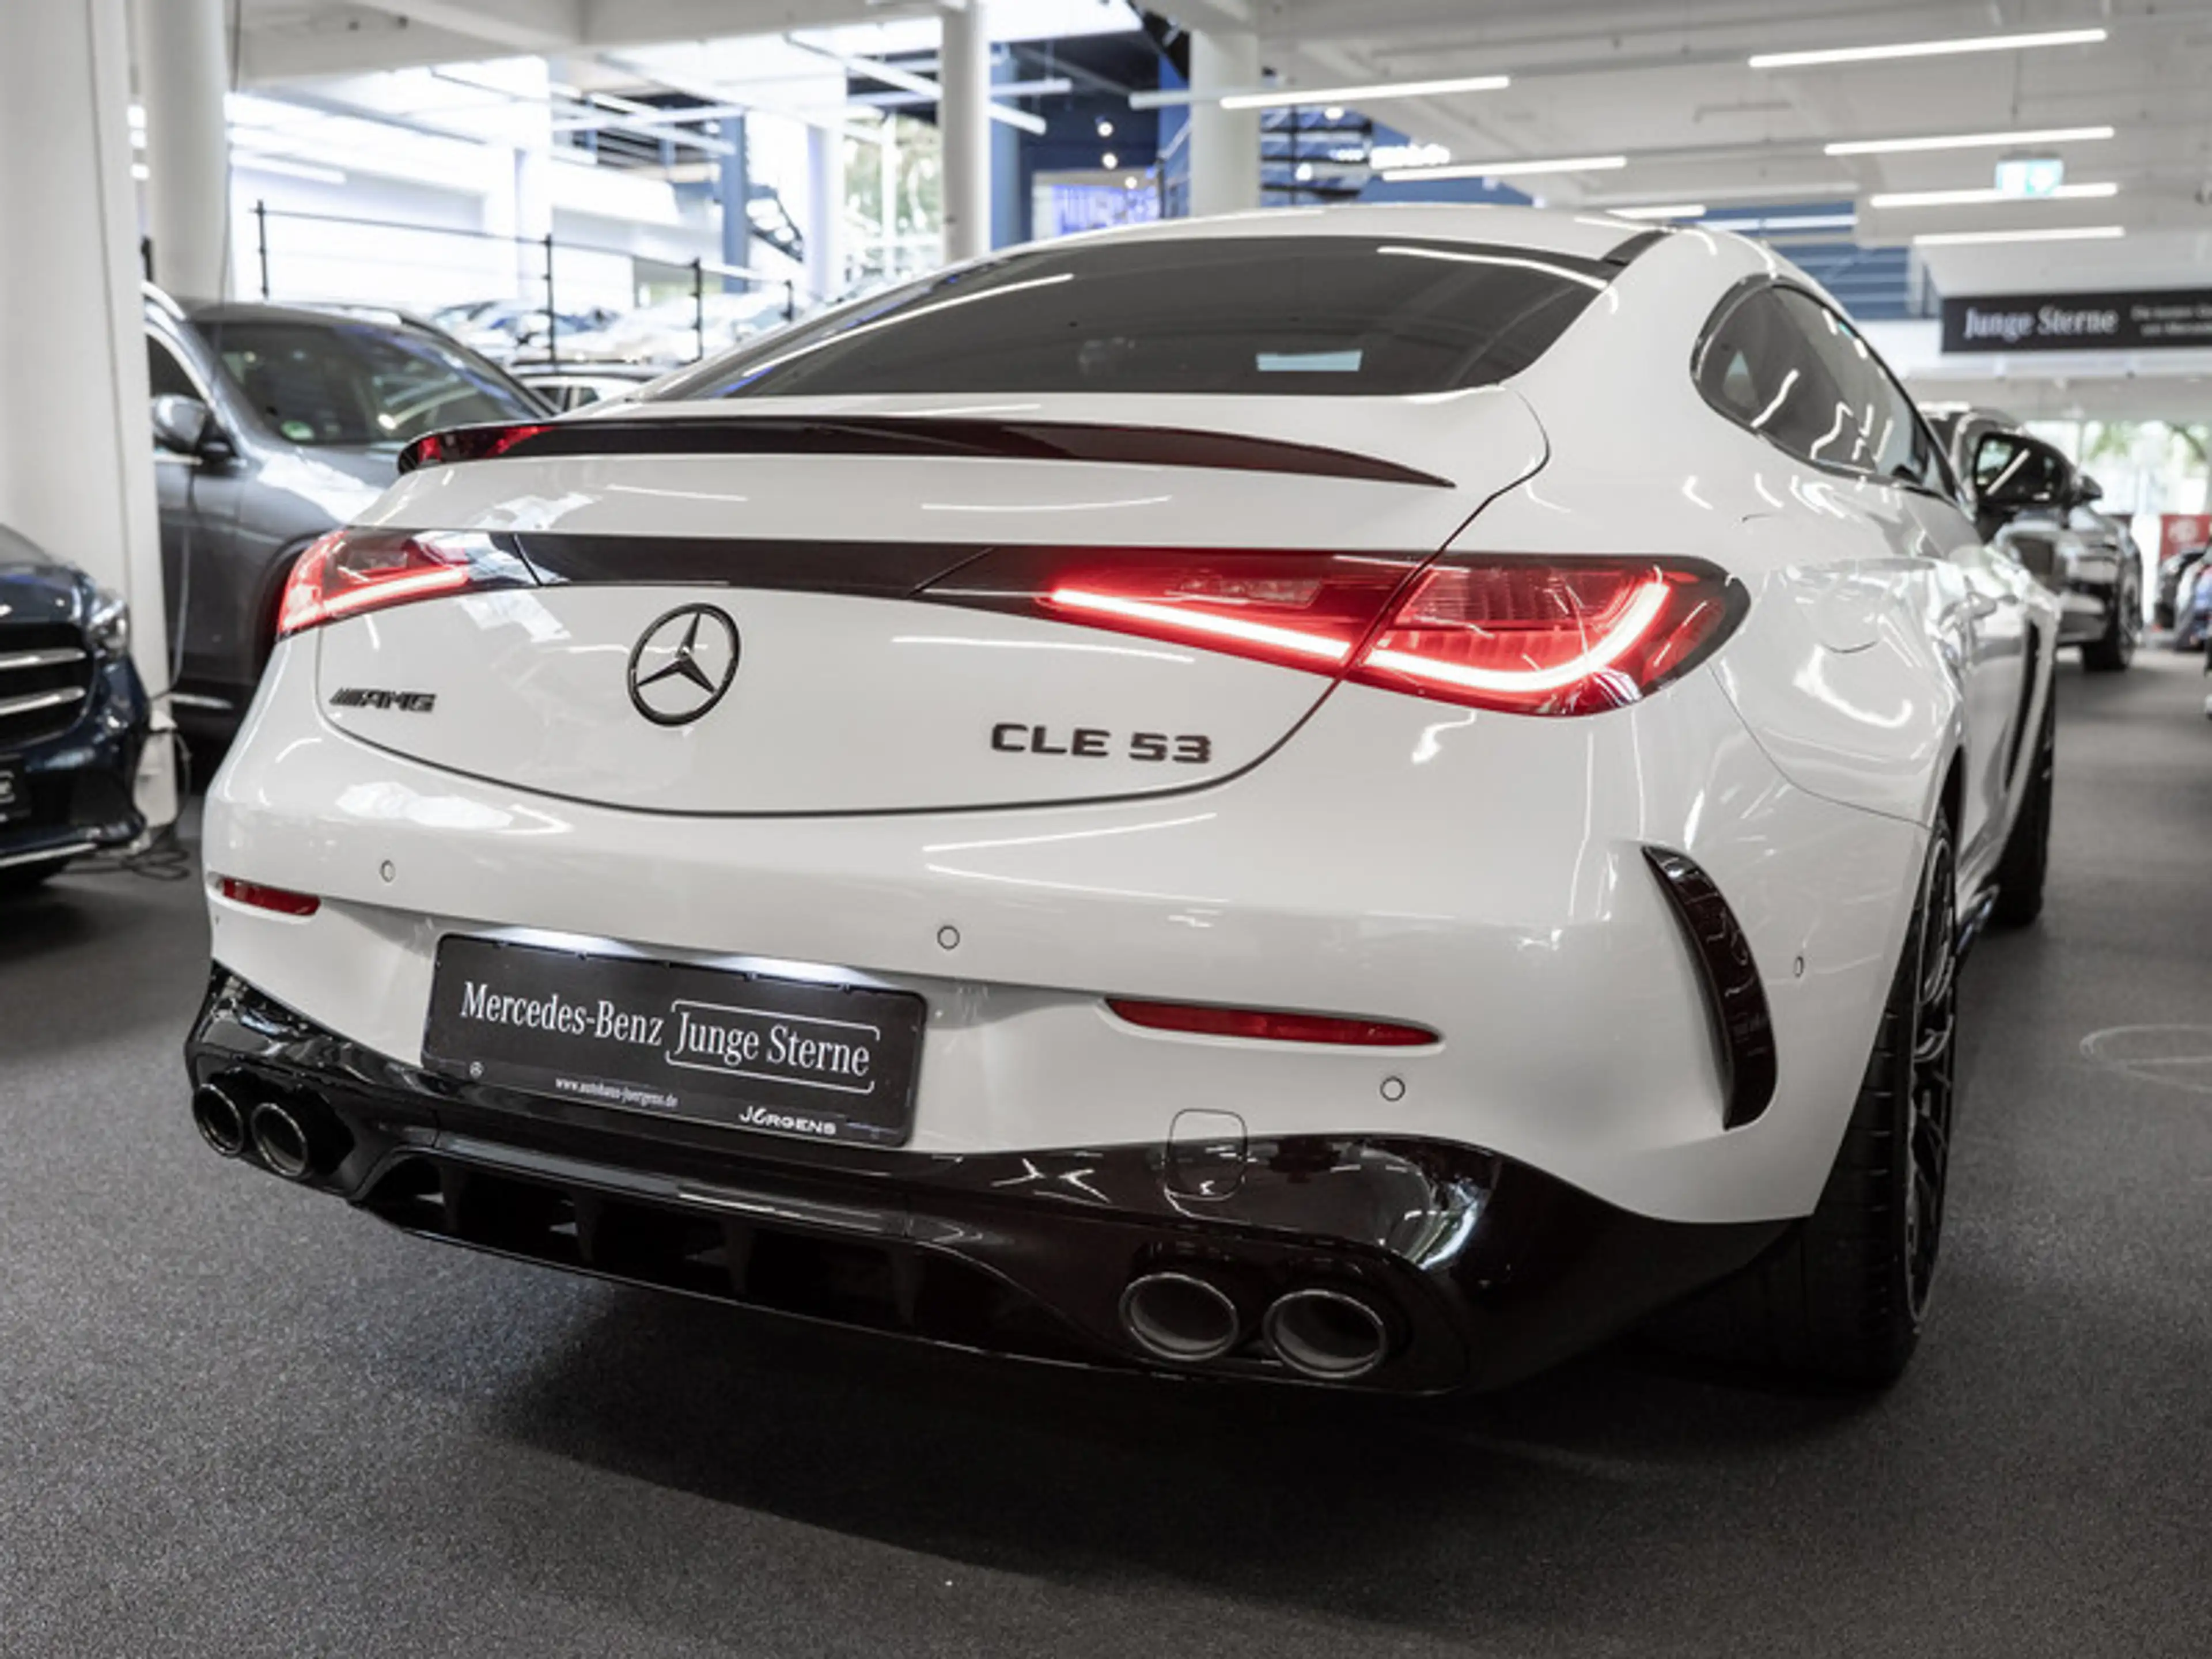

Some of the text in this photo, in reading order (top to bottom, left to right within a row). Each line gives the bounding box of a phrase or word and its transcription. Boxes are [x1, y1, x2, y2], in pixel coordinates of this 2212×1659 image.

[1963, 306, 2034, 342] Junge
[2037, 304, 2119, 335] Sterne
[990, 722, 1212, 764] CLE 53
[460, 980, 870, 1076] Mercedes-Benz Junge Sterne
